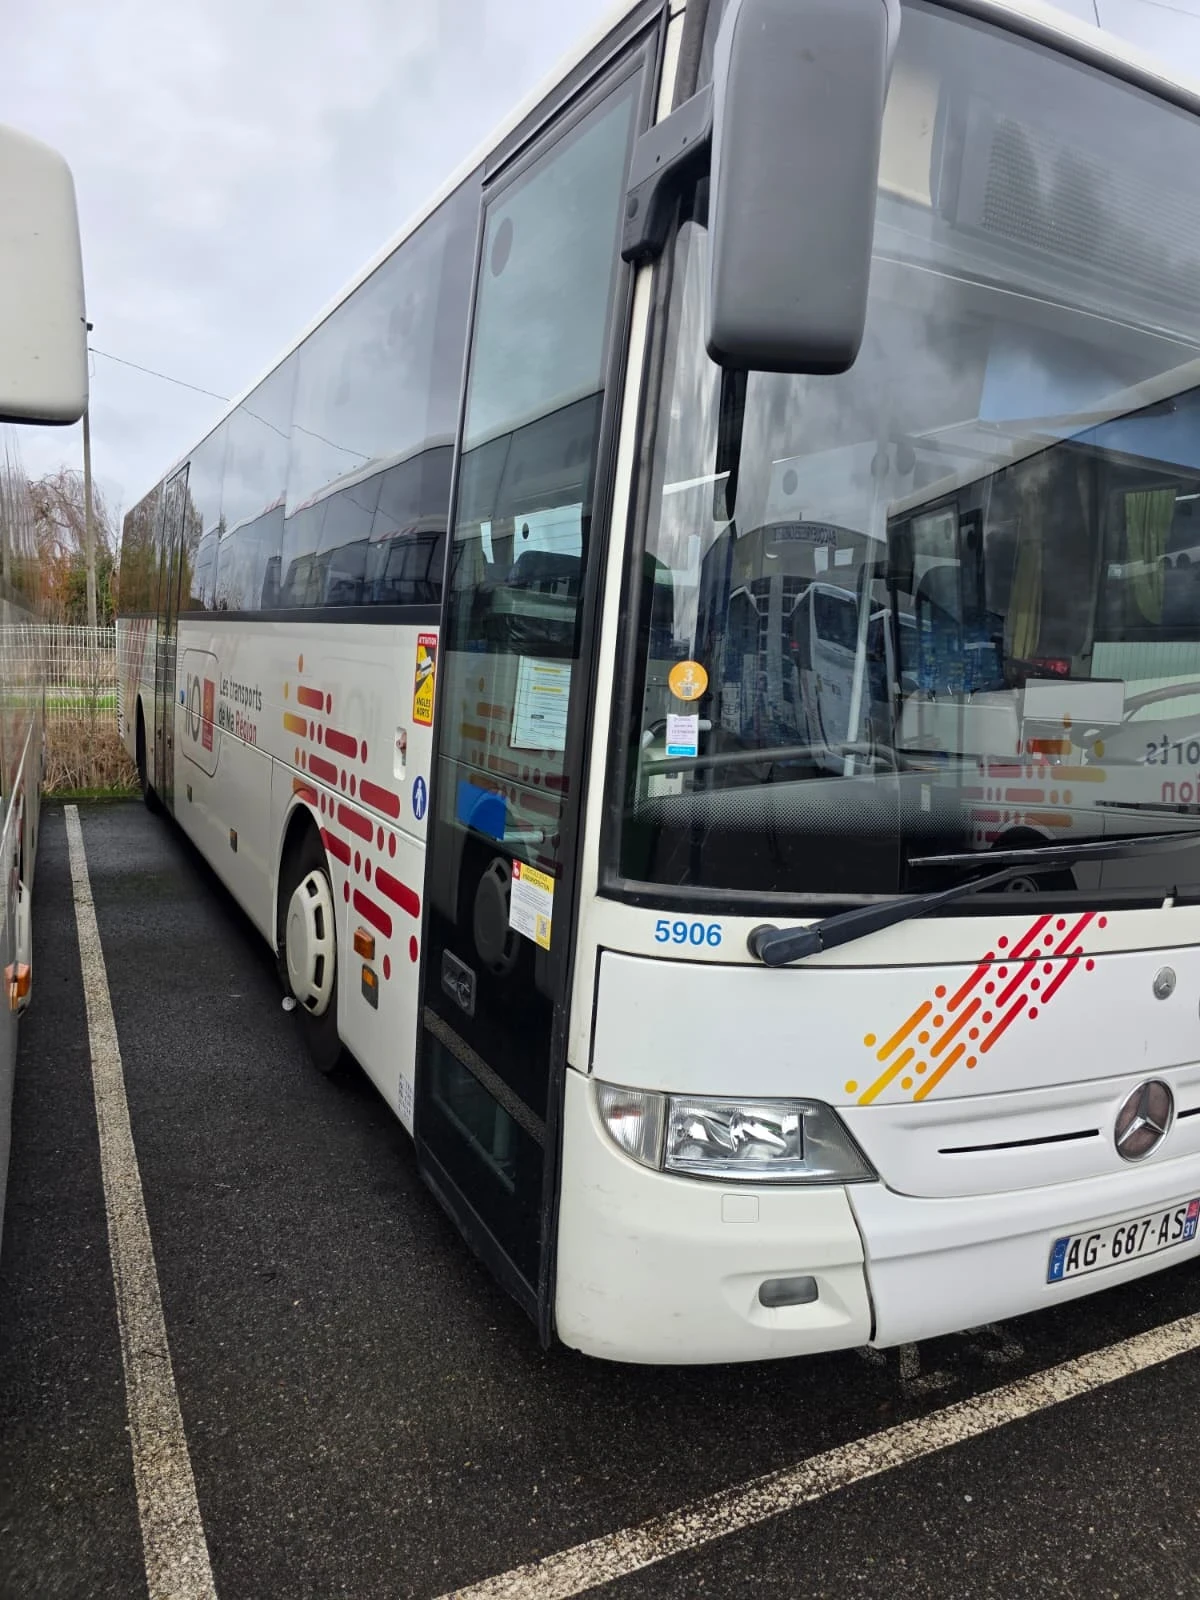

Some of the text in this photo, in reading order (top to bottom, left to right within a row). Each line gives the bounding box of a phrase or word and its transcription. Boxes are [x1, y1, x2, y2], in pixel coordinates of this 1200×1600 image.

[219, 671, 262, 712] Les transports
[416, 696, 431, 708] ANGLES
[416, 706, 430, 718] MORTS
[218, 701, 226, 727] de
[235, 709, 257, 745] Région
[654, 920, 722, 946] 5906
[1183, 1220, 1195, 1236] 31
[1065, 1207, 1187, 1272] AG-687-AS
[1054, 1263, 1061, 1275] F
